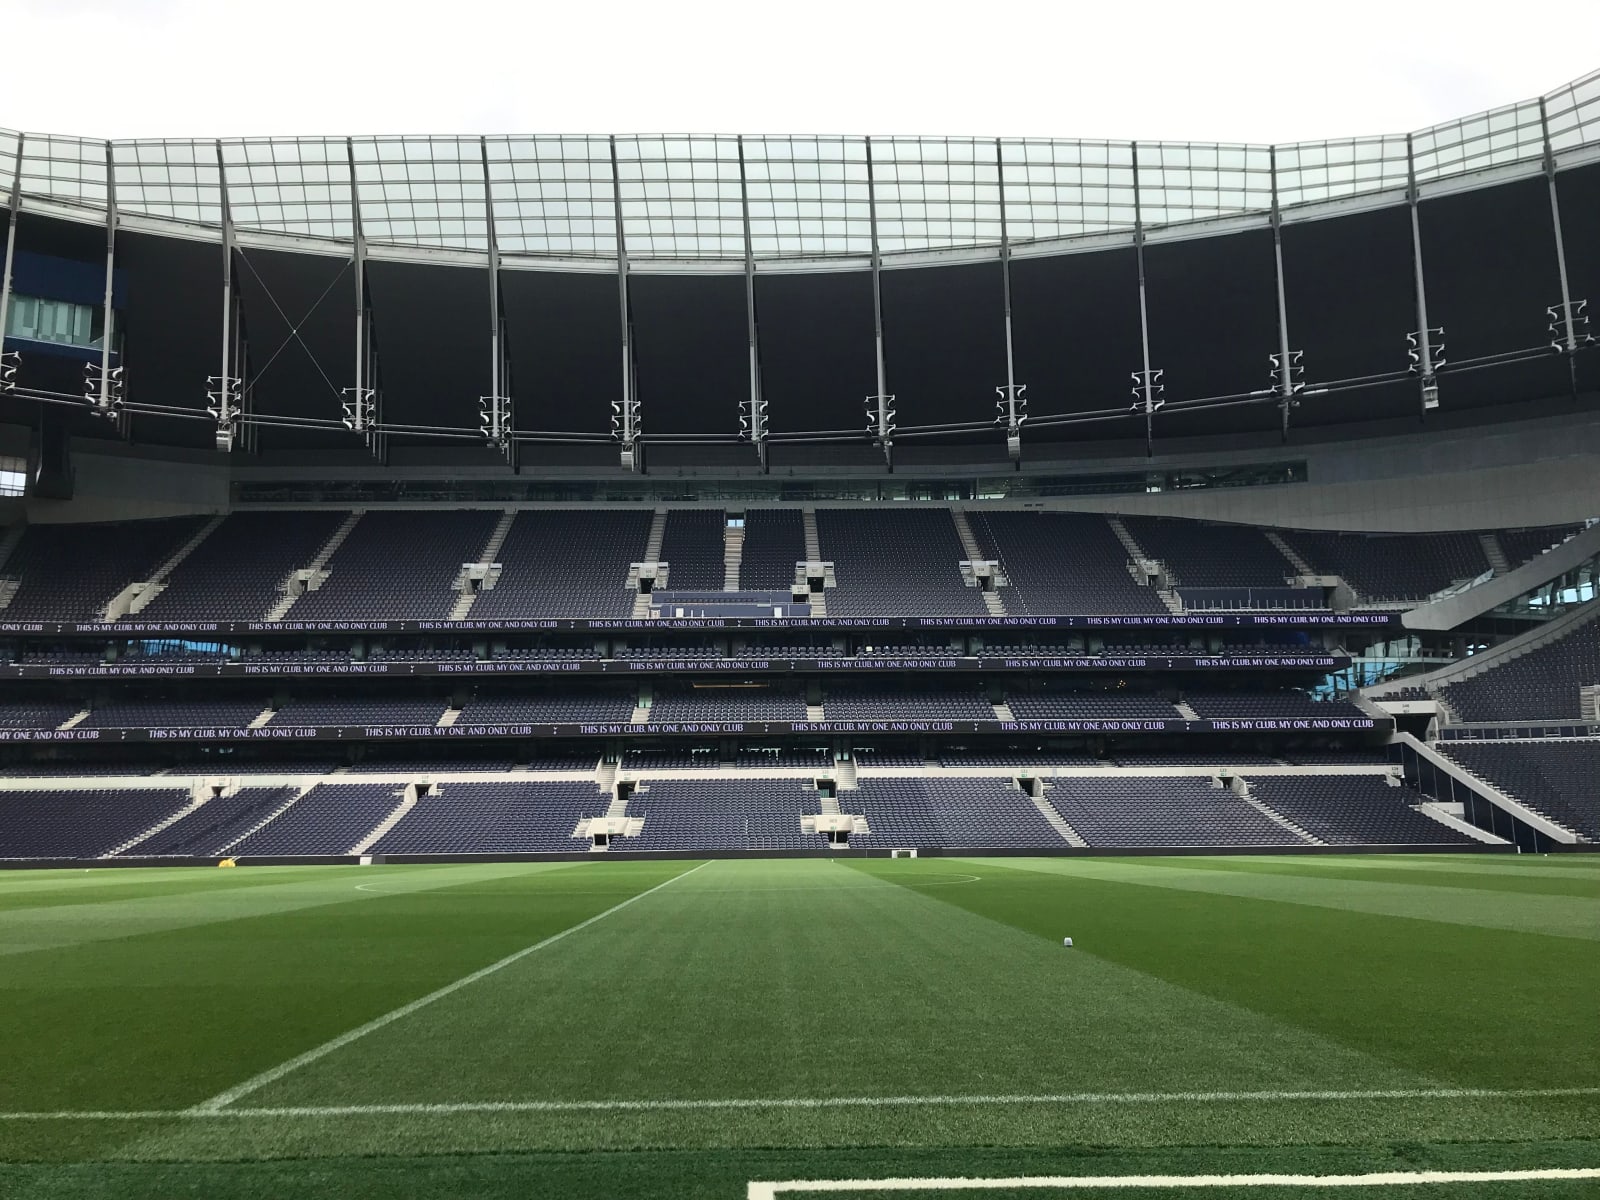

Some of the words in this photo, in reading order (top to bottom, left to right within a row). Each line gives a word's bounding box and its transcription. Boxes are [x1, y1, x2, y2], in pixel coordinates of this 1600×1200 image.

[438, 664, 454, 672] THIS
[630, 662, 645, 670] THIS
[49, 667, 65, 675] THIS
[580, 725, 598, 733] THIS
[599, 725, 607, 733] IS
[608, 725, 622, 733] MY
[662, 724, 679, 732] ONE
[680, 724, 699, 732] AND
[700, 724, 722, 732] ONLY
[723, 724, 743, 732] CLUB
[791, 723, 808, 731] THIS
[810, 723, 818, 731] IS
[819, 723, 833, 731] MY
[858, 723, 871, 731] MY
[910, 722, 931, 730] ONLY
[932, 722, 952, 730] CLUB
[1001, 722, 1019, 730] THIS
[1020, 722, 1028, 730] IS
[1030, 722, 1043, 730] MY
[1069, 722, 1082, 730] MY
[1083, 722, 1100, 730] ONE
[1102, 722, 1120, 730] AND
[1212, 721, 1230, 729] THIS
[1231, 721, 1239, 729] IS
[1240, 721, 1254, 729] MY
[1279, 720, 1292, 728] MY
[1293, 720, 1310, 728] ONE
[1312, 720, 1330, 728] AND
[1331, 720, 1352, 728] ONLY
[1353, 720, 1374, 728] CLUB
[14, 731, 31, 739] ONE
[33, 731, 52, 739] AND
[54, 731, 75, 739] ONLY
[149, 730, 168, 738] THIS
[169, 730, 177, 738] IS
[178, 730, 193, 738] MY
[218, 729, 232, 737] MY
[233, 729, 250, 737] ONE
[252, 729, 270, 737] AND
[272, 729, 294, 737] ONLY
[295, 729, 316, 737] CLUB
[365, 728, 383, 736] THIS
[385, 728, 393, 736] IS
[395, 728, 408, 736] MY
[434, 727, 448, 736] MY
[449, 727, 466, 735] ONE
[468, 727, 486, 735] AND
[488, 727, 509, 735] ONLY
[510, 726, 531, 735] CLUB
